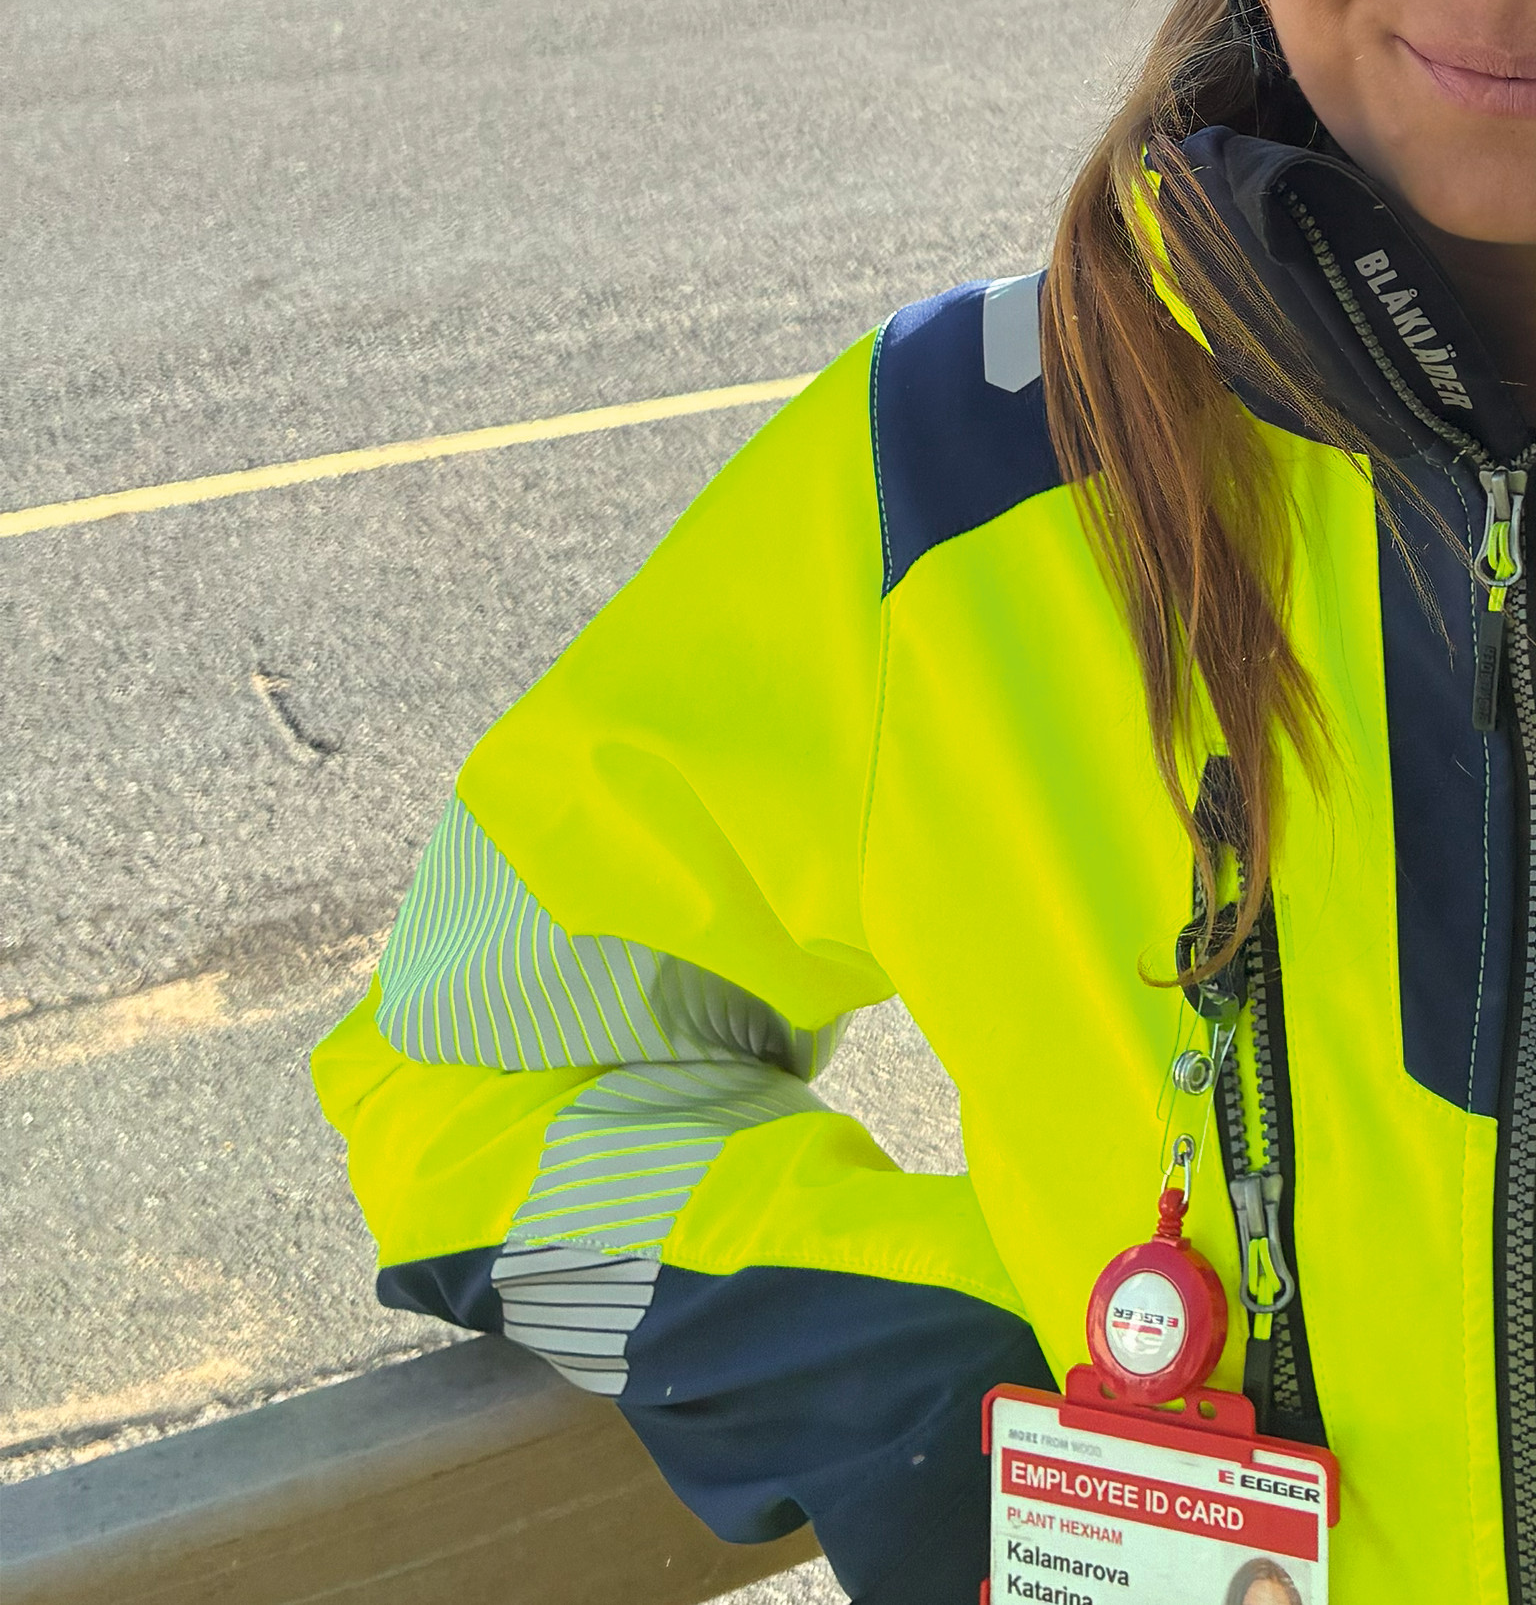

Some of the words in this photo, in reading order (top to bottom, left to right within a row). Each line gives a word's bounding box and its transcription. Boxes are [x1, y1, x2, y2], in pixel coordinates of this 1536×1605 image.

[1354, 248, 1474, 410] BLÅKLÄDER
[1011, 1460, 1139, 1509] EMPLOYEE
[1145, 1489, 1169, 1514] ID
[1174, 1496, 1244, 1531] CARD
[1240, 1474, 1320, 1504] EGGER
[1007, 1506, 1056, 1530] PLANT
[1059, 1518, 1123, 1546] HEXHAM
[1007, 1540, 1130, 1587] Kalamarova
[1007, 1573, 1093, 1605] Katarina
